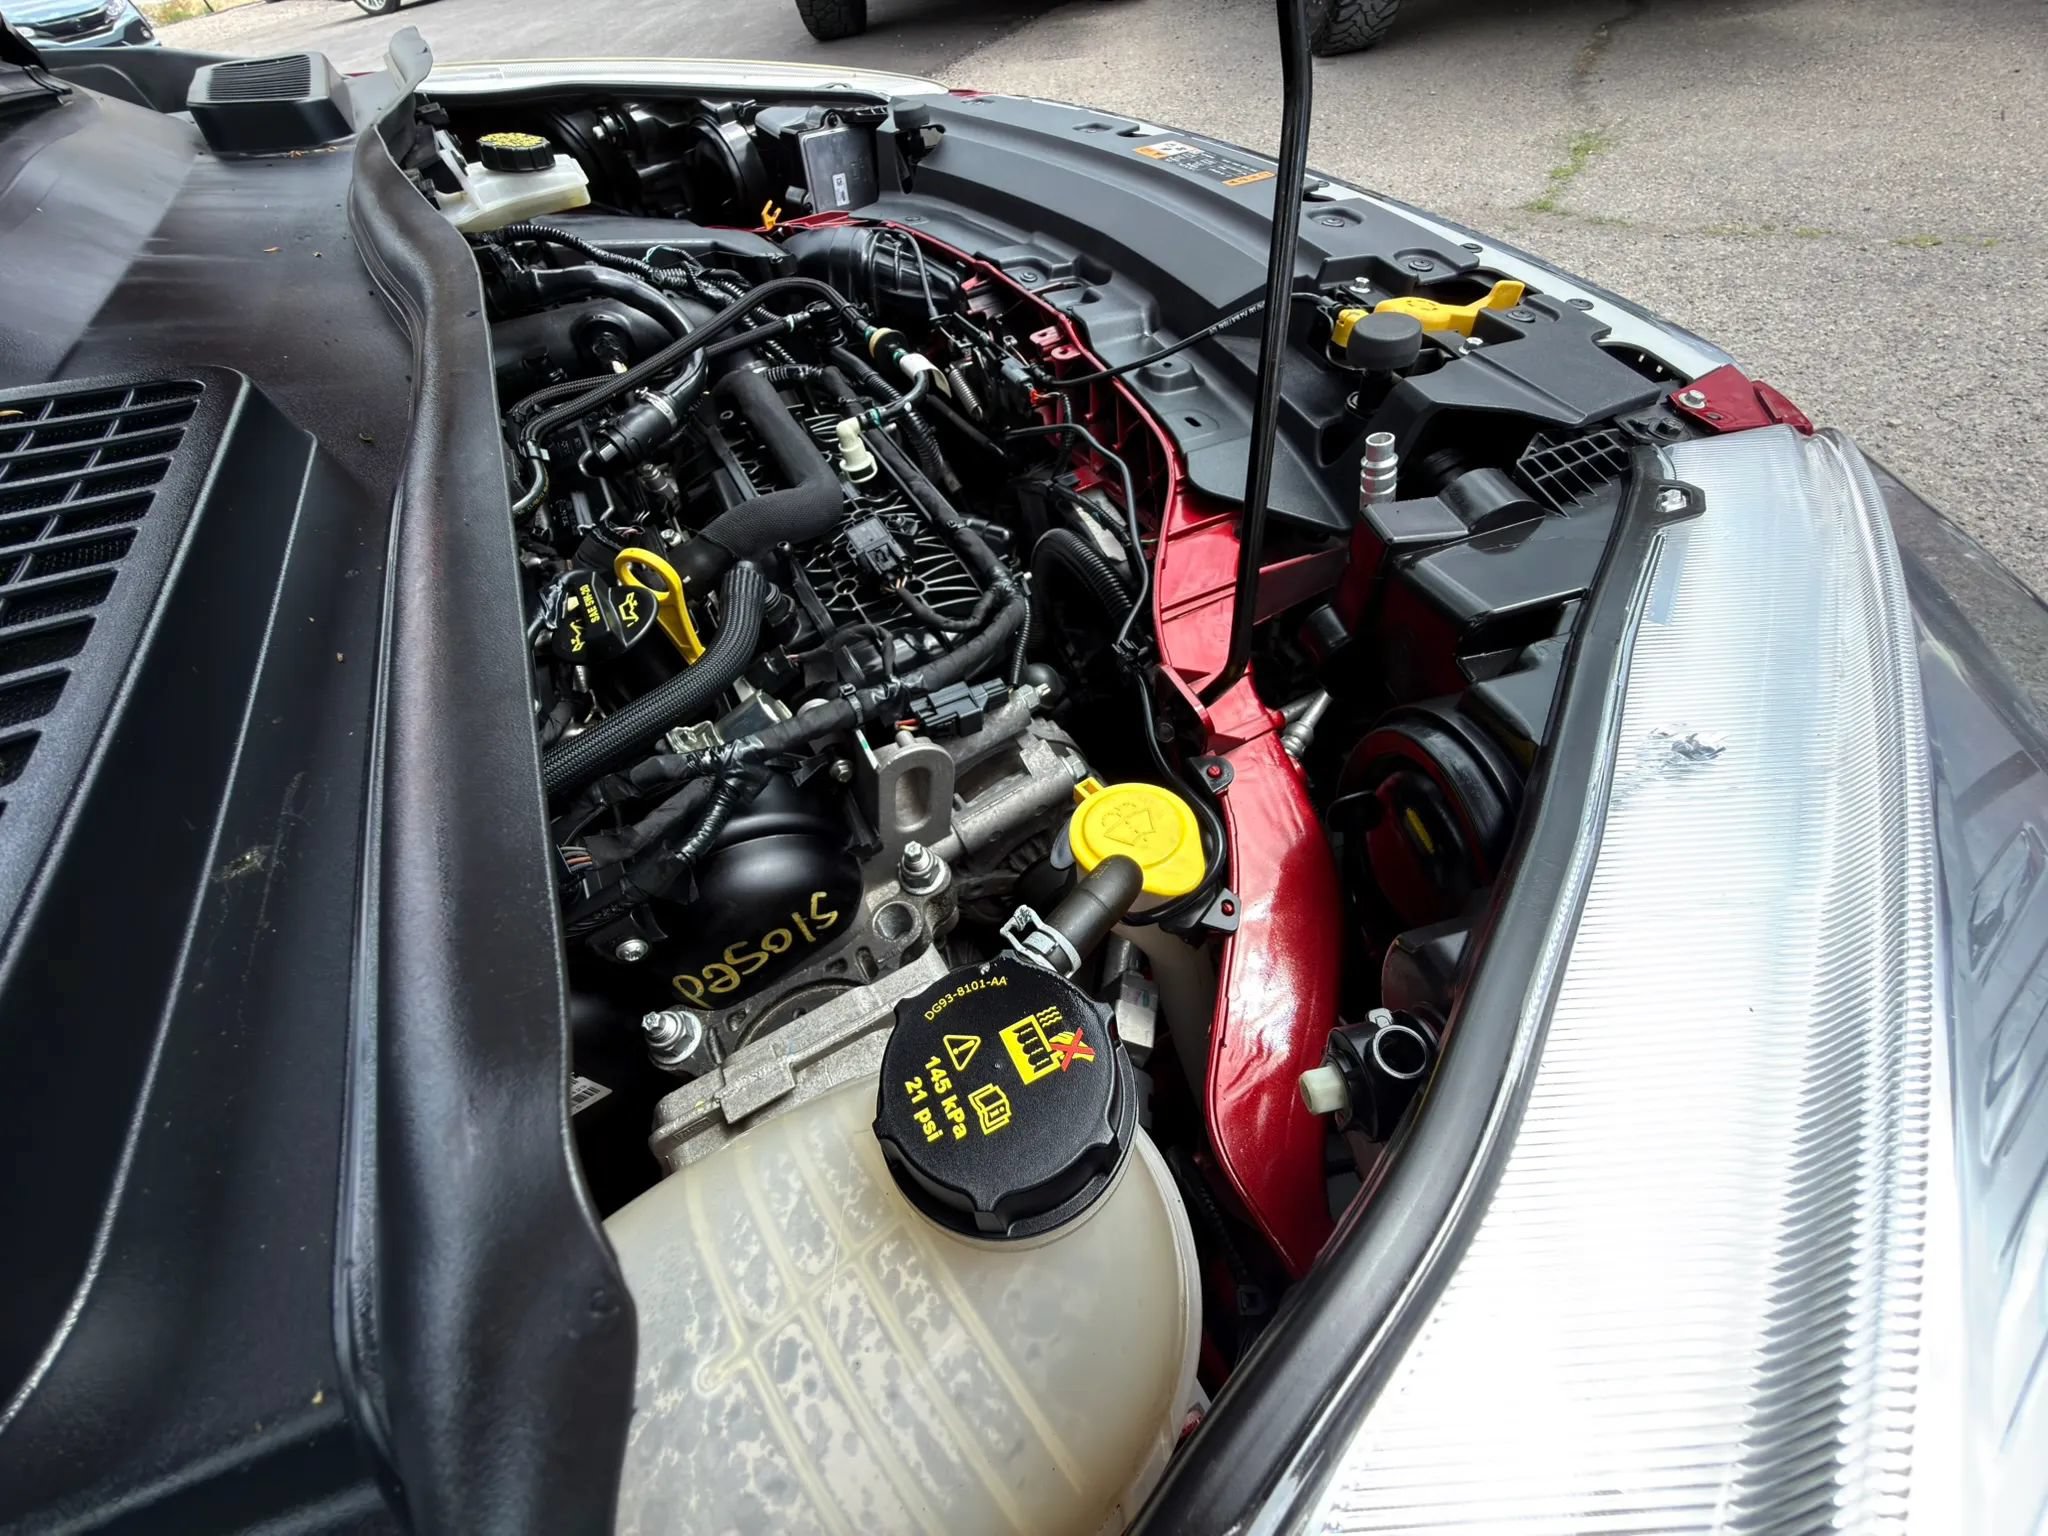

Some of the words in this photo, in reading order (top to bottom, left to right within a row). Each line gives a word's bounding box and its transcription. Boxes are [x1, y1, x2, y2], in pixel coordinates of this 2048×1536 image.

[580, 584, 594, 606] 5W-20
[587, 604, 600, 622] SAE
[925, 976, 1008, 1022] DG93-8101-AA
[905, 1077, 928, 1104] 21
[925, 1056, 952, 1094] 145
[941, 1094, 967, 1140] kPa
[914, 1107, 943, 1142] psi
